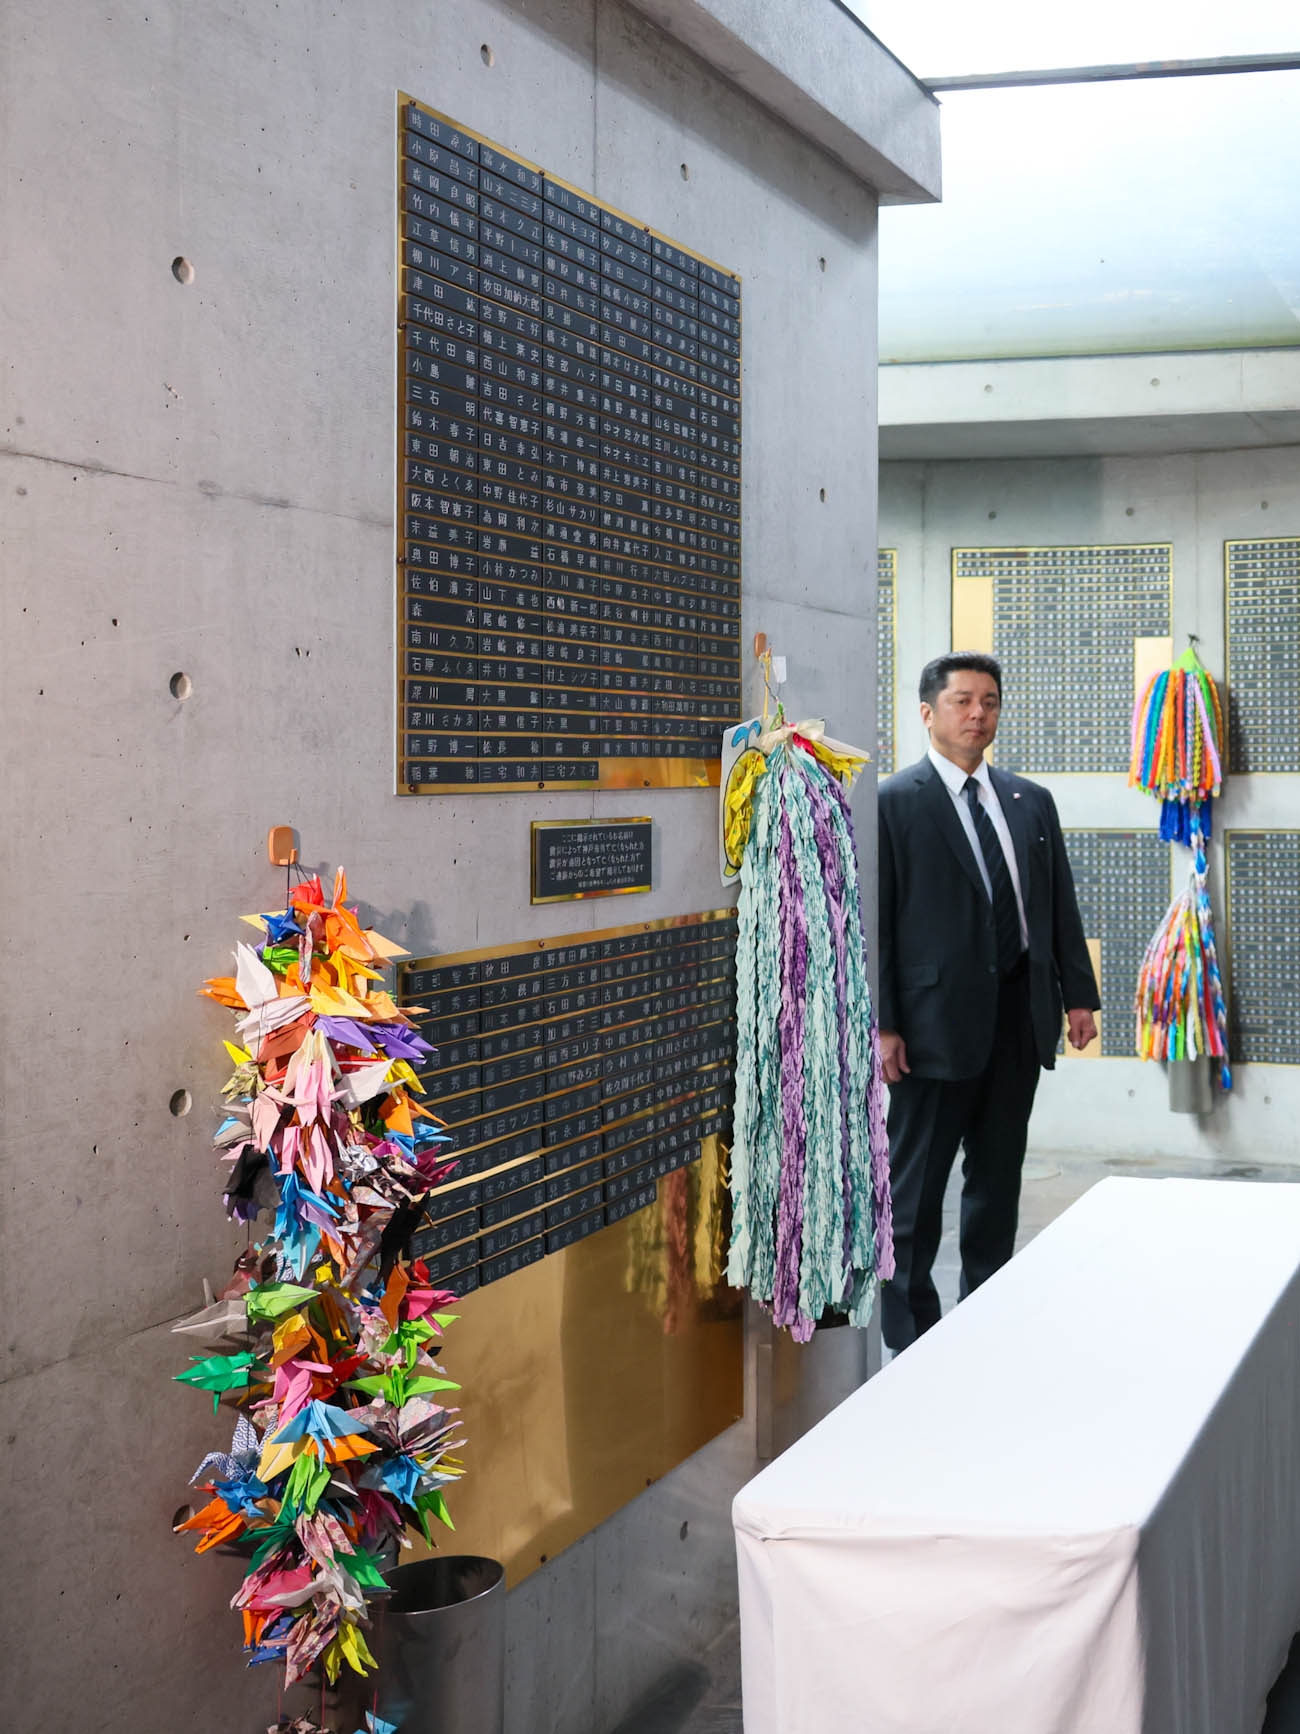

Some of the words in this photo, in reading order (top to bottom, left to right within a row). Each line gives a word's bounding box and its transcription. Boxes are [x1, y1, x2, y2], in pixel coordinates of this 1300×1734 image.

[412, 222, 475, 260] 江草信男
[412, 303, 476, 338] 千代田さと子
[483, 354, 540, 386] 西山和彦
[411, 385, 476, 417] 三石明
[482, 381, 539, 411] 吉田さと
[411, 410, 476, 441] 鈴木春子
[482, 458, 538, 482] 東田とみ
[482, 483, 539, 508] 中野佳代子
[410, 629, 474, 650] 南川久乃
